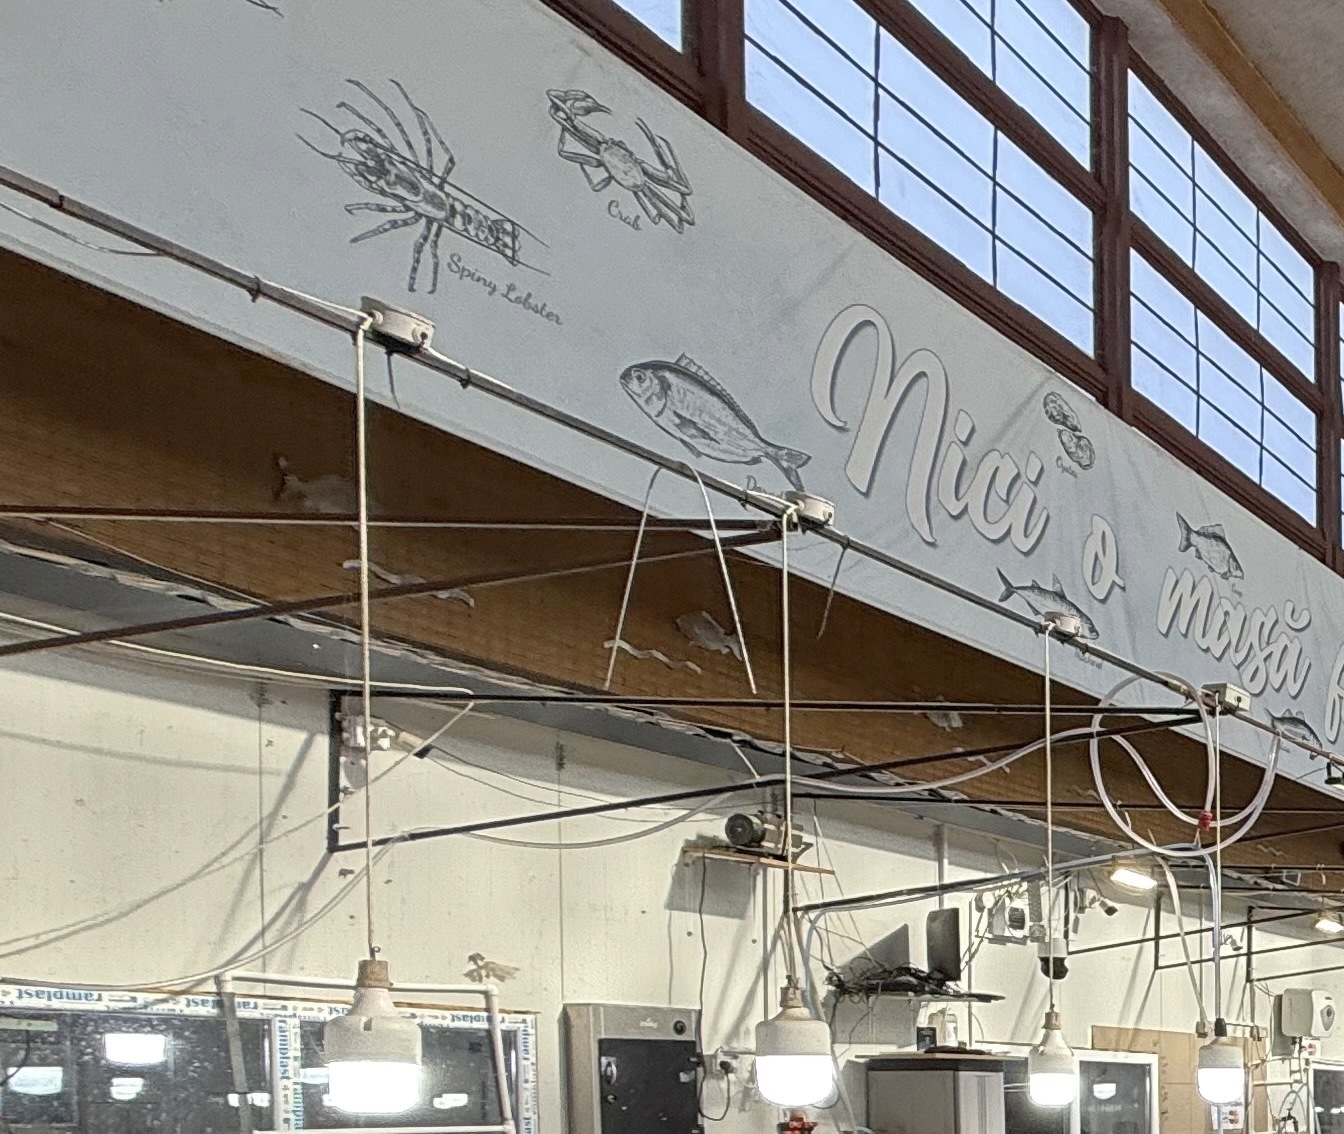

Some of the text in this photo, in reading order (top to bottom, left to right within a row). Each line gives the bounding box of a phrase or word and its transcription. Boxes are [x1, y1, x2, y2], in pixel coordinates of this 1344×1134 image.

[607, 199, 643, 231] Crab
[447, 253, 564, 326] Spiny Lobster
[809, 303, 1050, 557] Nici
[1082, 514, 1126, 604] o
[1156, 565, 1312, 700] masă
[16, 987, 103, 1002] ramplast
